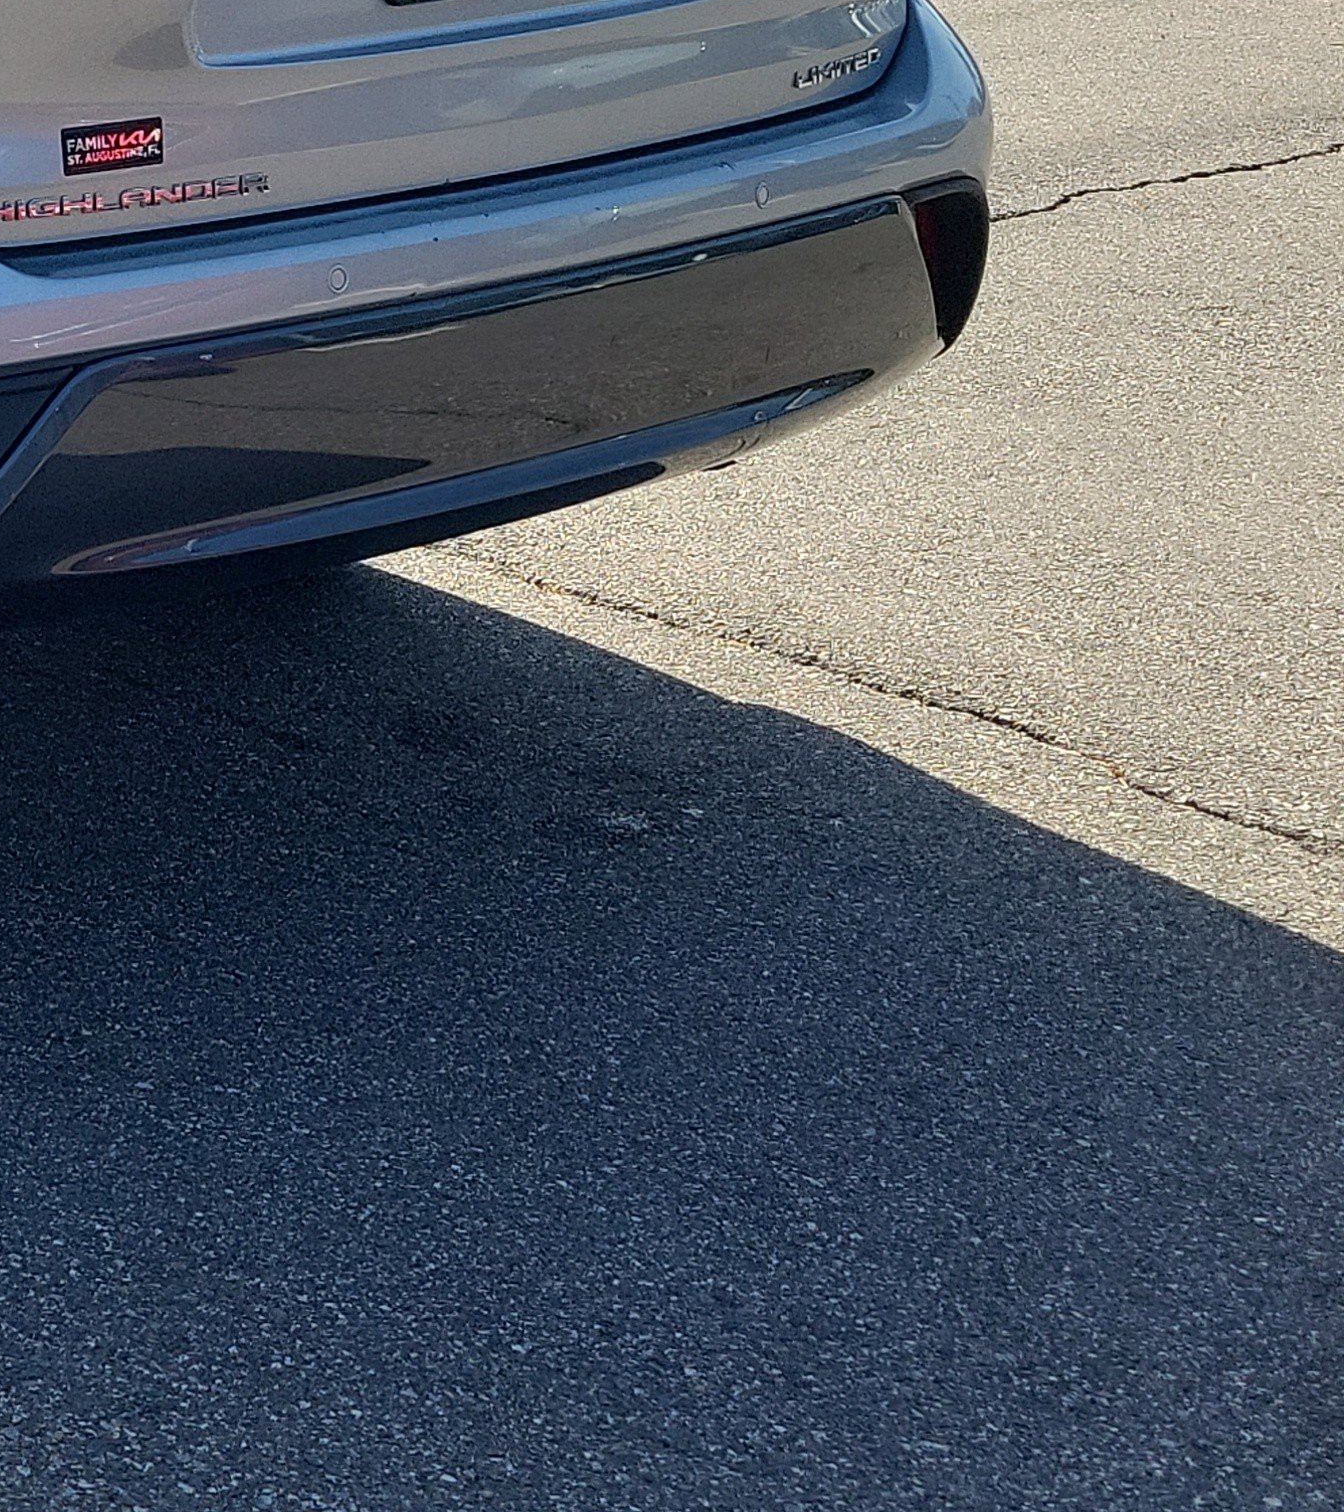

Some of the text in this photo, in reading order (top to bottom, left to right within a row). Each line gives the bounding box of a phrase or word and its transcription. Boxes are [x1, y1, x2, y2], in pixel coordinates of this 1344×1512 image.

[66, 133, 118, 153] FAMILY
[67, 154, 83, 166] ST.
[148, 144, 162, 156] FL
